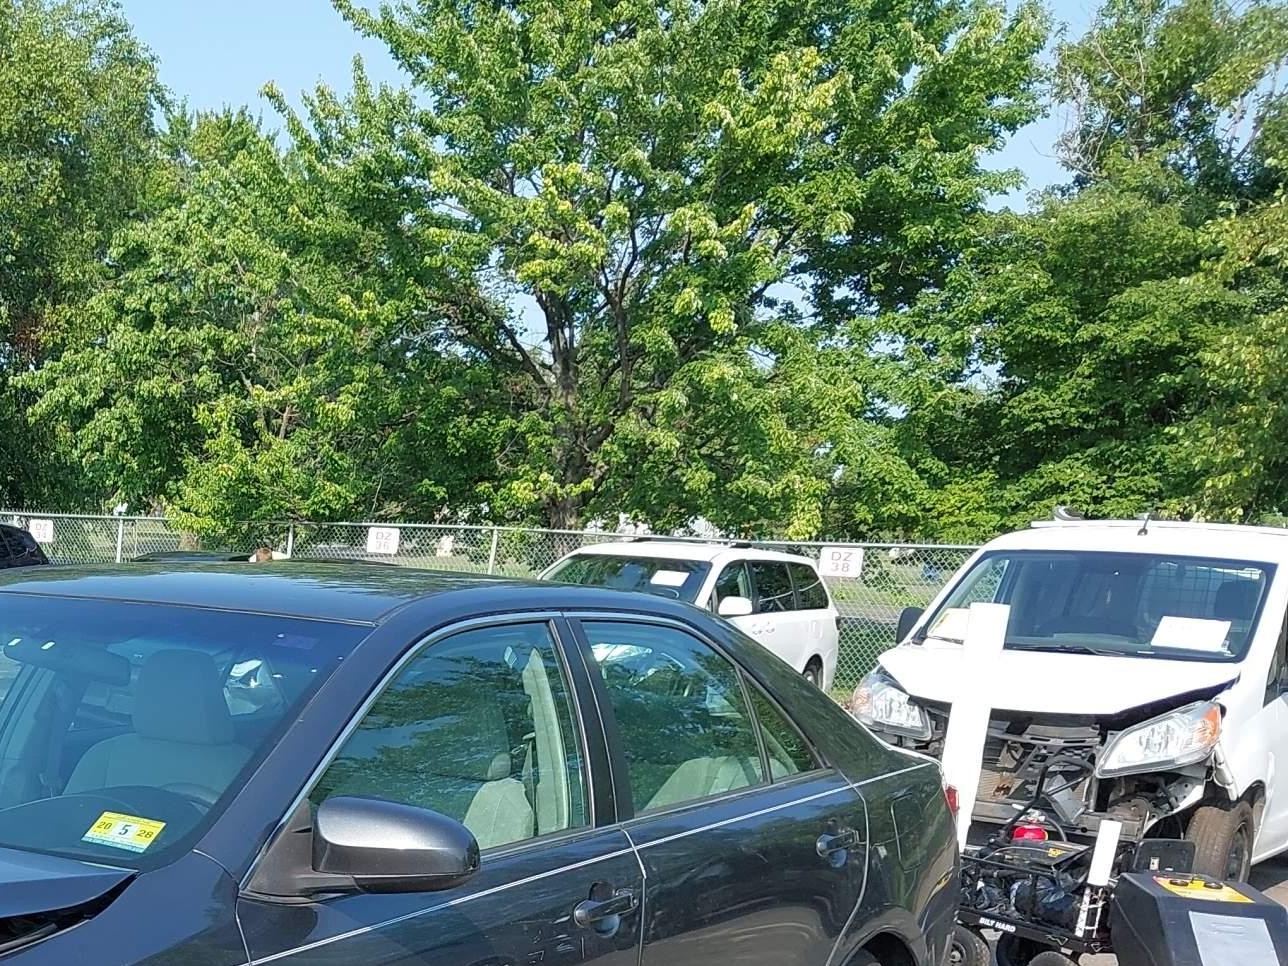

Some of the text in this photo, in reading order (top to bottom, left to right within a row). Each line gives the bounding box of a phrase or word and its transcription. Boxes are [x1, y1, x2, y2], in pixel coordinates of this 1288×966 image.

[831, 551, 853, 561] DZ
[831, 562, 850, 572] 38
[96, 821, 113, 830] 20
[118, 824, 132, 836] 5
[136, 829, 154, 839] 28
[995, 922, 1016, 933] HARD
